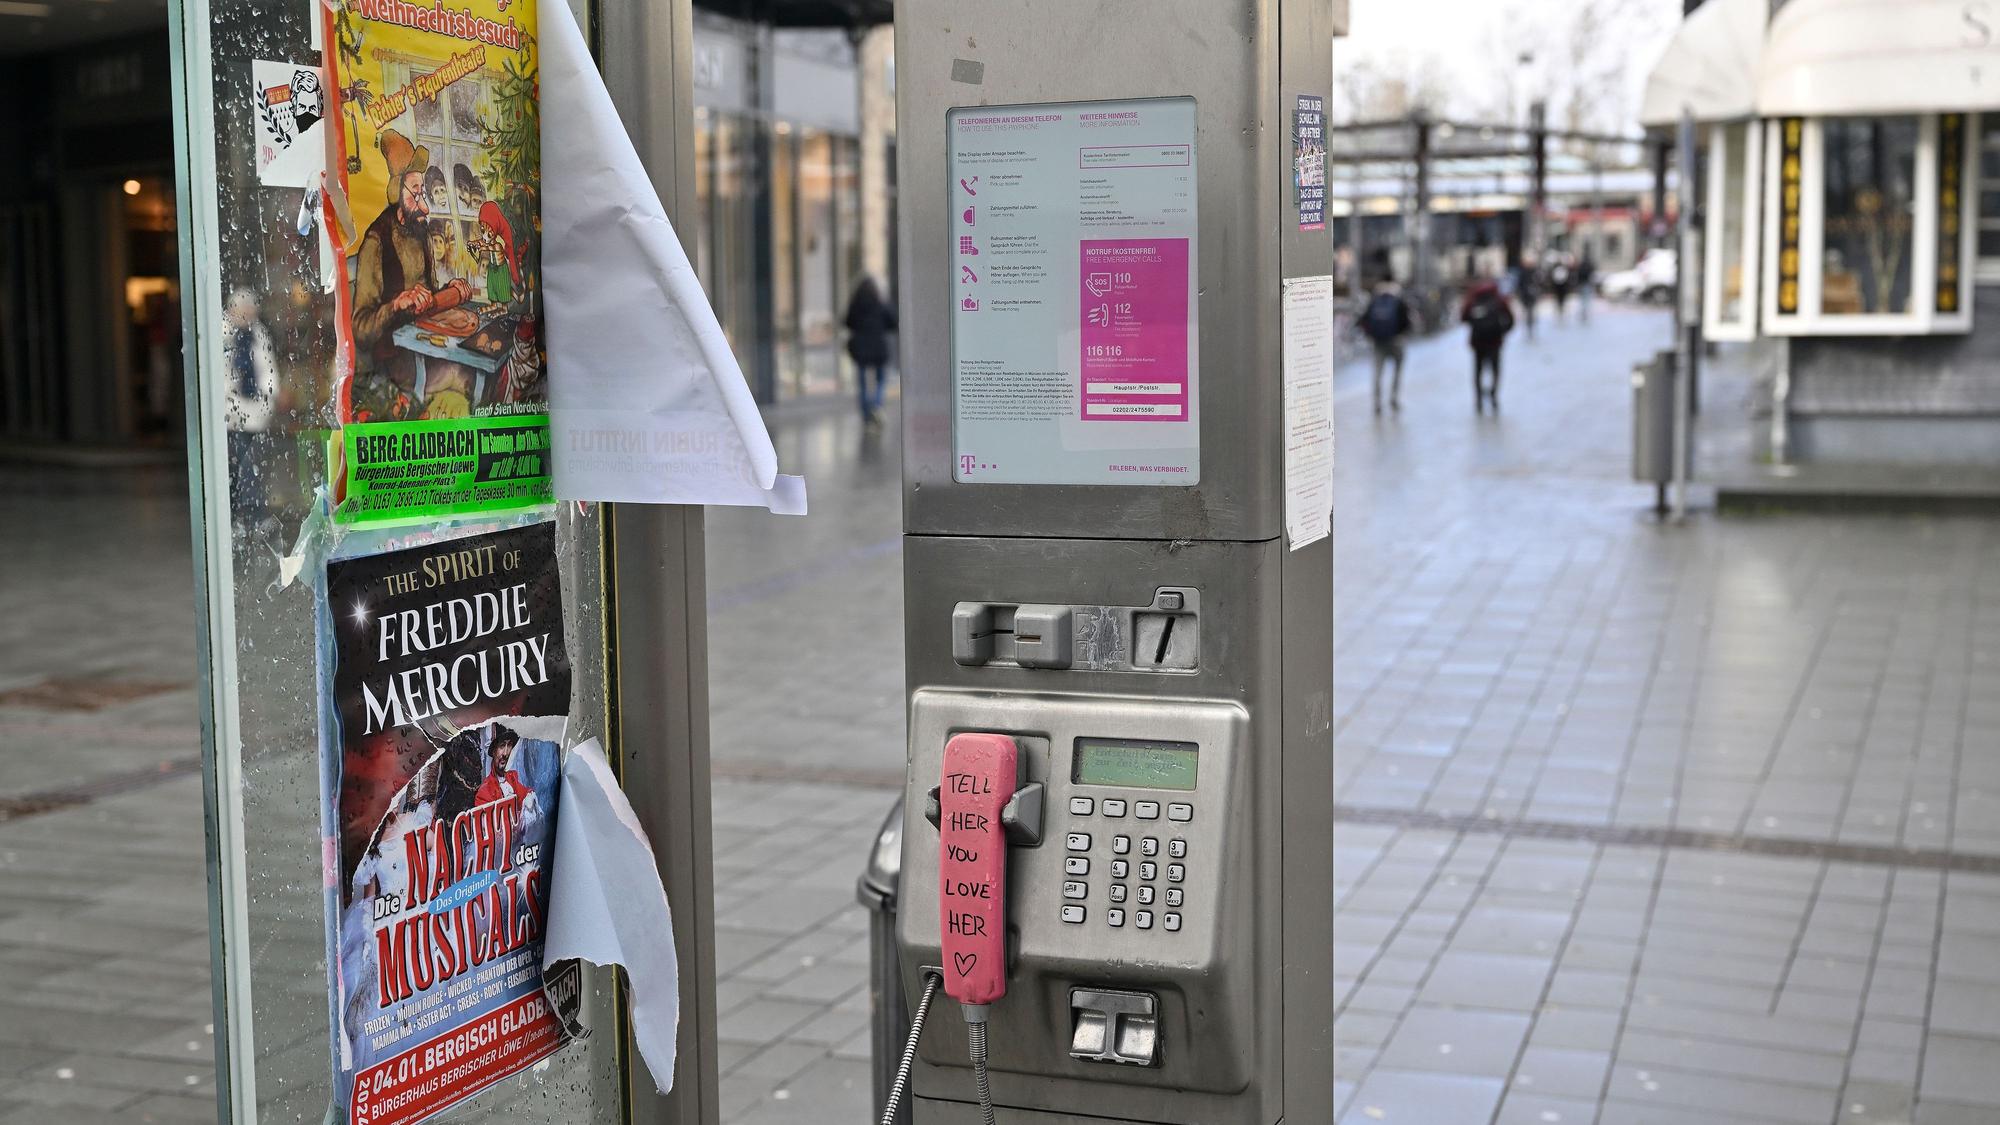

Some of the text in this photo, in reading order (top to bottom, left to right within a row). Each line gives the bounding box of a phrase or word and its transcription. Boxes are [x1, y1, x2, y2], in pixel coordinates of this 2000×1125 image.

[358, 0, 520, 50] Weihnachtsbesuch
[414, 45, 486, 104] Figurentheater
[958, 117, 1001, 126] TELEFONIEREN
[1115, 273, 1131, 283] 110
[1115, 304, 1131, 313] 112
[1086, 346, 1122, 356] 116 116
[475, 400, 549, 416] nach Sven Nordqvist
[356, 430, 475, 465] BERG.GLADBACH
[354, 460, 475, 481] Bürgerhaus Bergischer Loewe
[1109, 464, 1138, 473] ERLEBEN,
[368, 477, 450, 491] Konrad-Adenauer-Platz
[414, 489, 428, 506] 123
[428, 488, 452, 505] Tickets
[474, 486, 506, 504] Tageskasse
[507, 482, 514, 498] 30
[383, 544, 521, 597] THE SPIRIT OF
[377, 583, 531, 663] FREDDIE
[362, 632, 551, 736] MERCURY
[946, 773, 992, 794] TELL
[951, 813, 990, 833] HER
[404, 794, 520, 911] NACHT
[515, 843, 539, 867] der
[947, 844, 978, 862] YOU
[1142, 840, 1148, 849] 2
[1171, 842, 1176, 851] 3
[1112, 863, 1174, 875] 4 5 6
[435, 871, 492, 912] Das Original!
[945, 878, 991, 899] LOVE
[1112, 886, 1174, 899] 7 8 9
[373, 893, 400, 921] Die
[1063, 908, 1069, 916] C
[1138, 914, 1142, 922] 0
[949, 910, 987, 938] HER
[376, 868, 543, 1010] MUSICALS
[364, 1014, 391, 1037] FROZEN
[397, 1000, 422, 1022] MOULIN
[422, 990, 444, 1008] ROUGE
[448, 977, 472, 999] WICKED
[476, 962, 506, 986] PHANTOM
[506, 955, 518, 973] DER
[518, 950, 532, 967] OPER
[372, 965, 536, 1052] MAMMA MIA SISTER ACT GREASE ROCKY ELISABETH
[372, 1053, 423, 1095] 04.01.
[425, 1018, 498, 1072] BERGISCH
[501, 997, 552, 1036] GLADBA
[372, 1076, 438, 1120] BÜRGERHAUS
[440, 1048, 496, 1088] BERGISCHER
[498, 1034, 522, 1059] LÖWE
